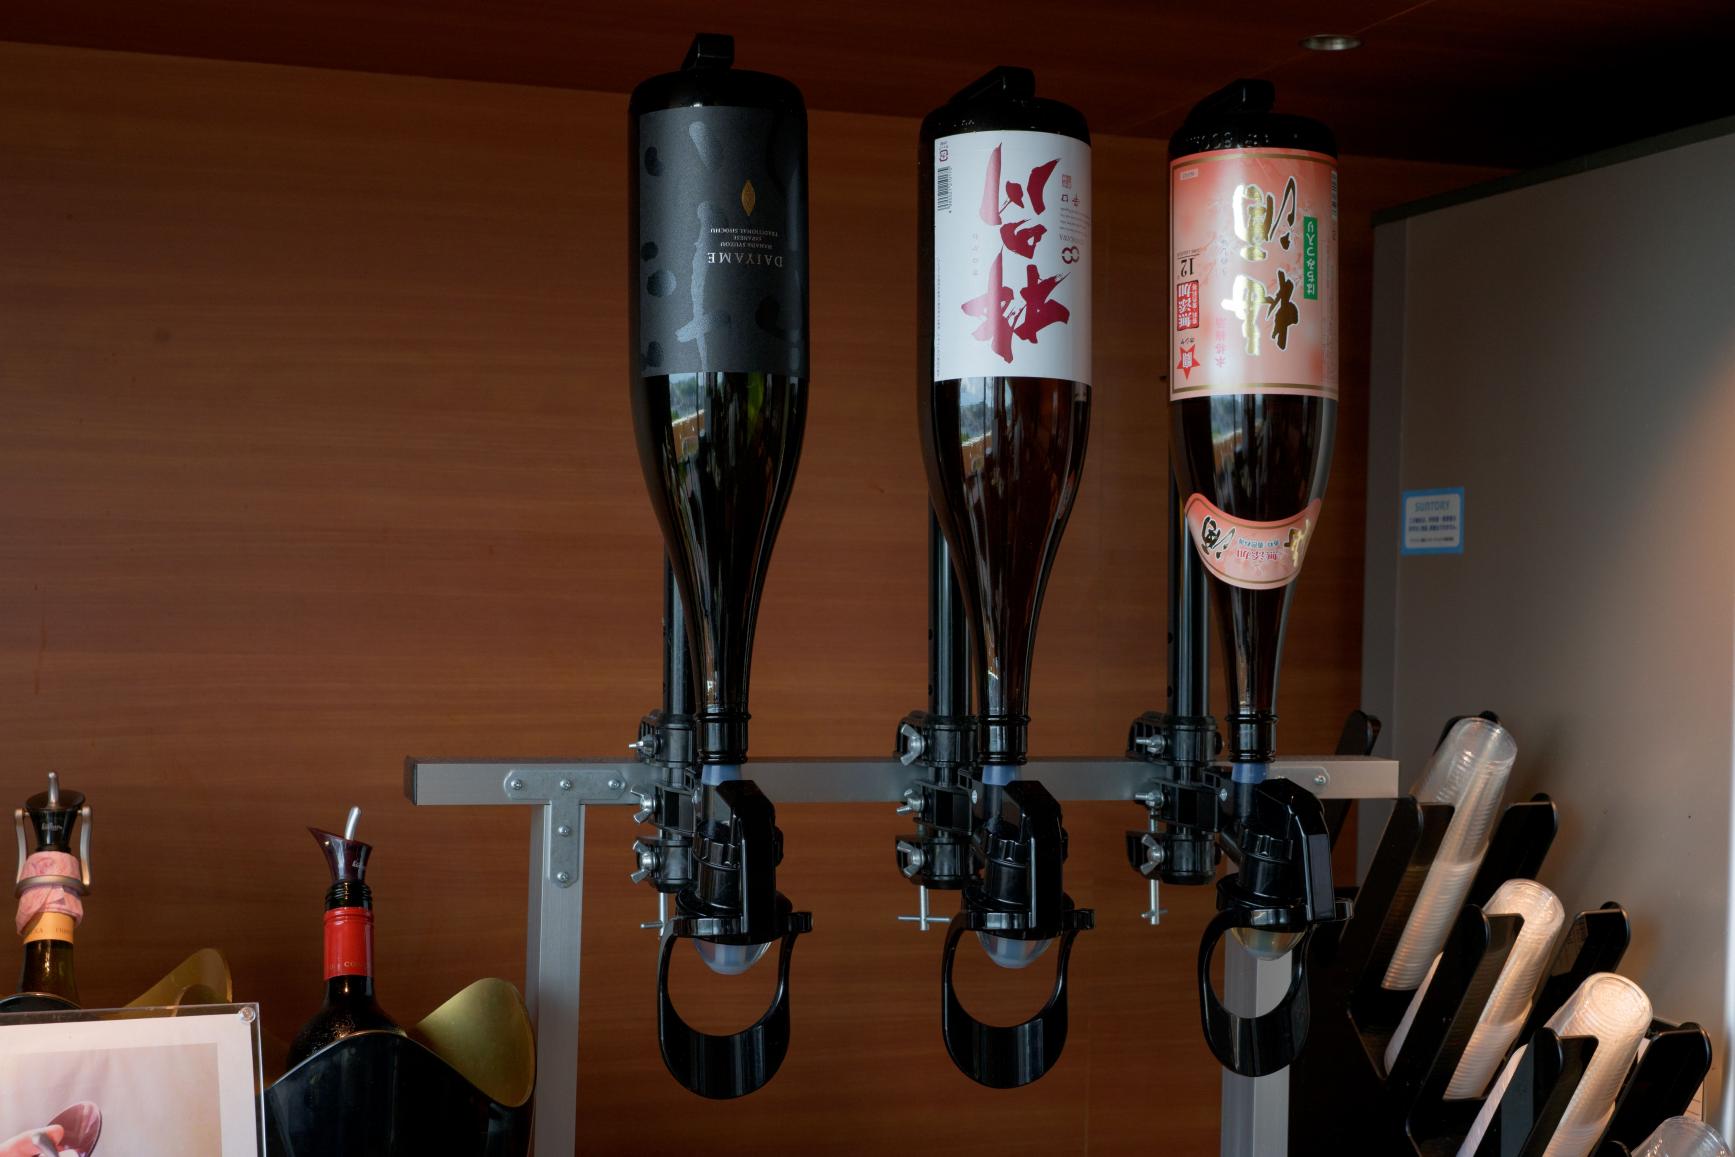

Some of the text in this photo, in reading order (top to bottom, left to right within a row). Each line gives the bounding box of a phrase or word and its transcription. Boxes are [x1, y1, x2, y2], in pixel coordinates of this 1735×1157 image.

[707, 252, 783, 267] DAIYAME
[1305, 221, 1316, 294] はちみつ入り
[1181, 258, 1194, 277] 12
[1178, 283, 1191, 327] 無添加
[1236, 549, 1279, 561] 無添加
